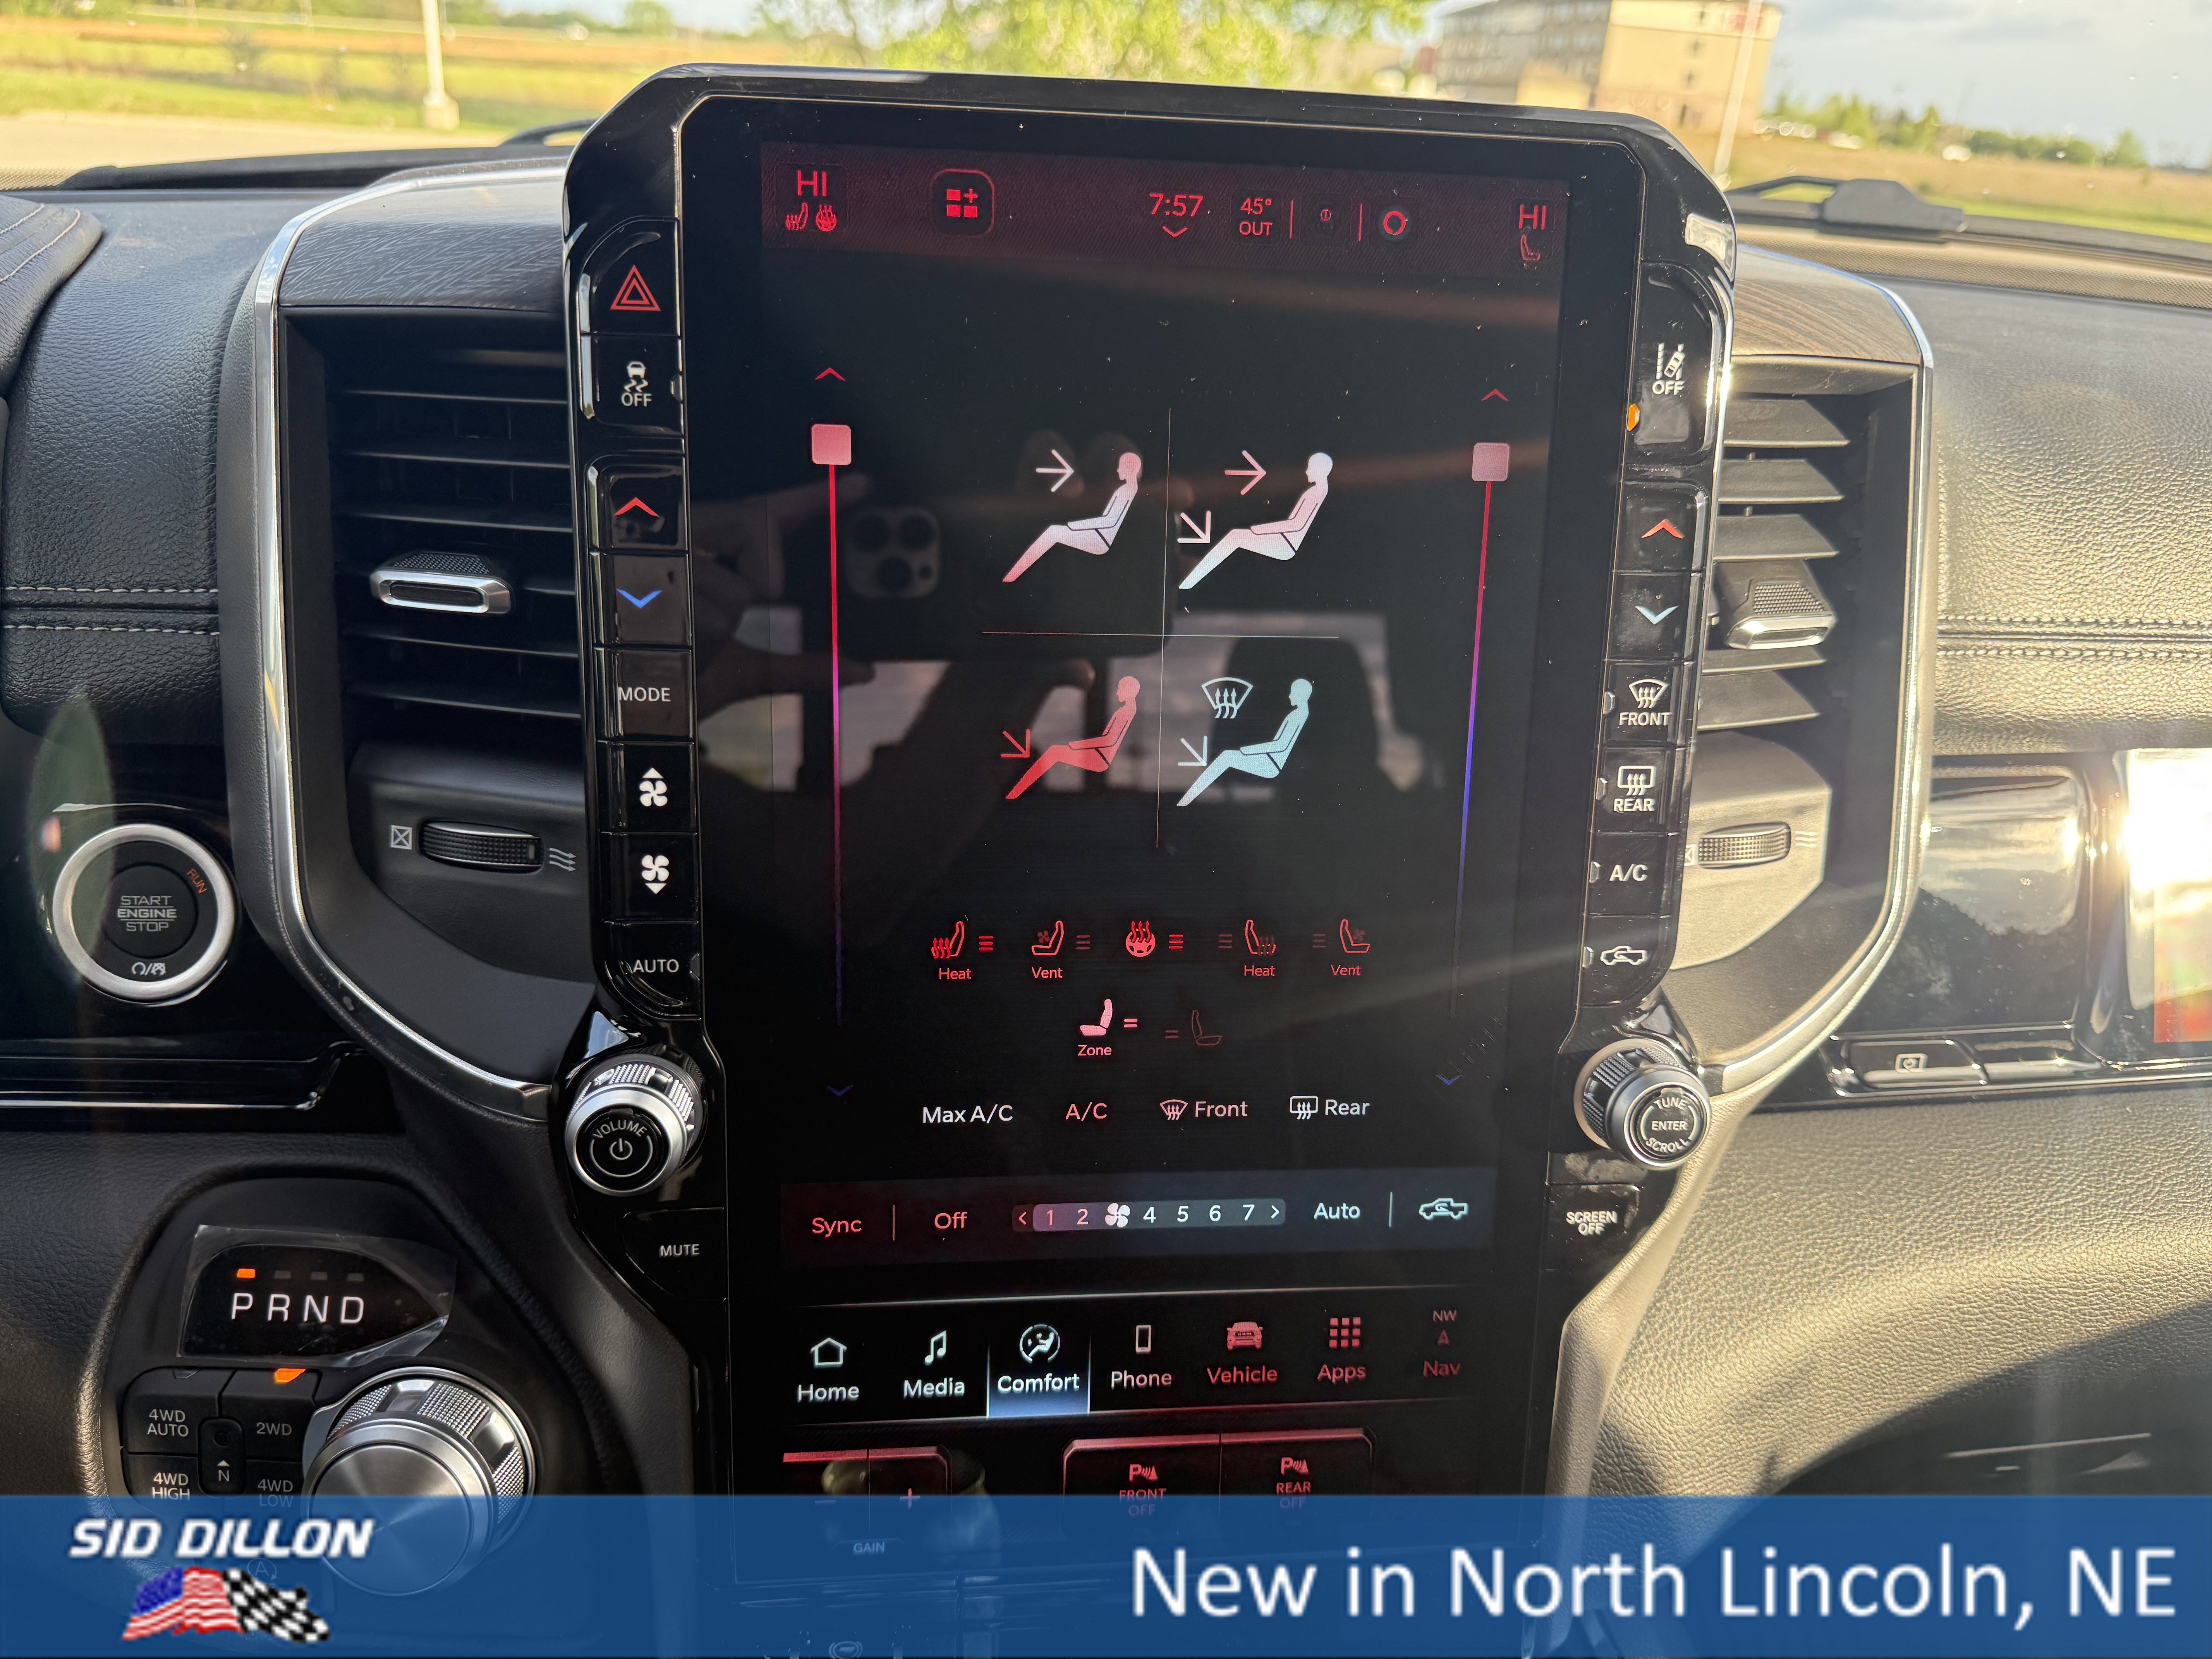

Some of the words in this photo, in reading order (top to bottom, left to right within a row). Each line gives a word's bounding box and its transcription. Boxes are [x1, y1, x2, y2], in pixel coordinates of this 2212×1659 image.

[797, 170, 827, 196] HI
[1149, 193, 1203, 217] 7:57
[1240, 197, 1273, 215] 45°
[1518, 203, 1546, 230] HI
[1239, 222, 1273, 236] OUT
[1652, 380, 1685, 395] OFF
[621, 392, 652, 407] OFF
[618, 687, 671, 702] MODE
[1619, 712, 1672, 726] FRONT
[1613, 798, 1655, 812] REAR
[1609, 864, 1648, 882] A/C
[187, 868, 208, 895] RUN
[120, 895, 173, 906] START
[117, 908, 178, 919] ENGINE
[126, 922, 169, 932] STOP
[632, 958, 680, 973] AUTO
[1031, 966, 1063, 979] Vent
[1243, 963, 1276, 977] Heat
[1331, 964, 1362, 976] Vent
[939, 967, 972, 980] Heat
[1078, 1045, 1112, 1057] Zone
[1194, 1101, 1249, 1118] Front
[1325, 1099, 1370, 1116] Rear
[1654, 1097, 1689, 1110] TUNE
[922, 1106, 965, 1124] Max
[970, 1104, 1013, 1123] A/C
[1065, 1103, 1108, 1121] A/C
[592, 1119, 648, 1140] VOLUME
[1651, 1120, 1689, 1131] ENTER
[1645, 1137, 1690, 1153] SCROLL
[1046, 1209, 1054, 1226] 1
[1077, 1209, 1089, 1226] 2
[1143, 1206, 1156, 1223] 4
[1177, 1205, 1189, 1223] 5
[1209, 1205, 1221, 1222] 6
[1242, 1204, 1255, 1221] 7
[1314, 1203, 1361, 1220] Auto
[1566, 1211, 1618, 1225] SCREEN
[811, 1217, 862, 1238] Sync
[934, 1211, 967, 1230] Off
[1578, 1222, 1606, 1236] OFF
[659, 1244, 701, 1257] MUTE
[1432, 1310, 1457, 1323] NW
[1207, 1365, 1278, 1384] Vehicle
[1317, 1364, 1367, 1384] Apps
[1422, 1360, 1462, 1377] Nav
[997, 1372, 1080, 1393] Comfort
[1111, 1370, 1172, 1390] Phone
[797, 1384, 860, 1403] Home
[903, 1377, 965, 1399] Media
[149, 1409, 185, 1423] 4WD
[147, 1423, 189, 1437] AUTO
[256, 1422, 292, 1436] 2WD
[153, 1472, 189, 1486] 4WD
[218, 1470, 230, 1482] N
[258, 1479, 294, 1493] 4WD
[1276, 1481, 1312, 1495] REAR
[152, 1487, 191, 1501] HIGH
[259, 1494, 294, 1508] LOW
[1119, 1488, 1167, 1503] FRONT
[1279, 1496, 1306, 1509] OFF
[1128, 1504, 1156, 1518] OFF
[853, 1541, 885, 1555] GAIN
